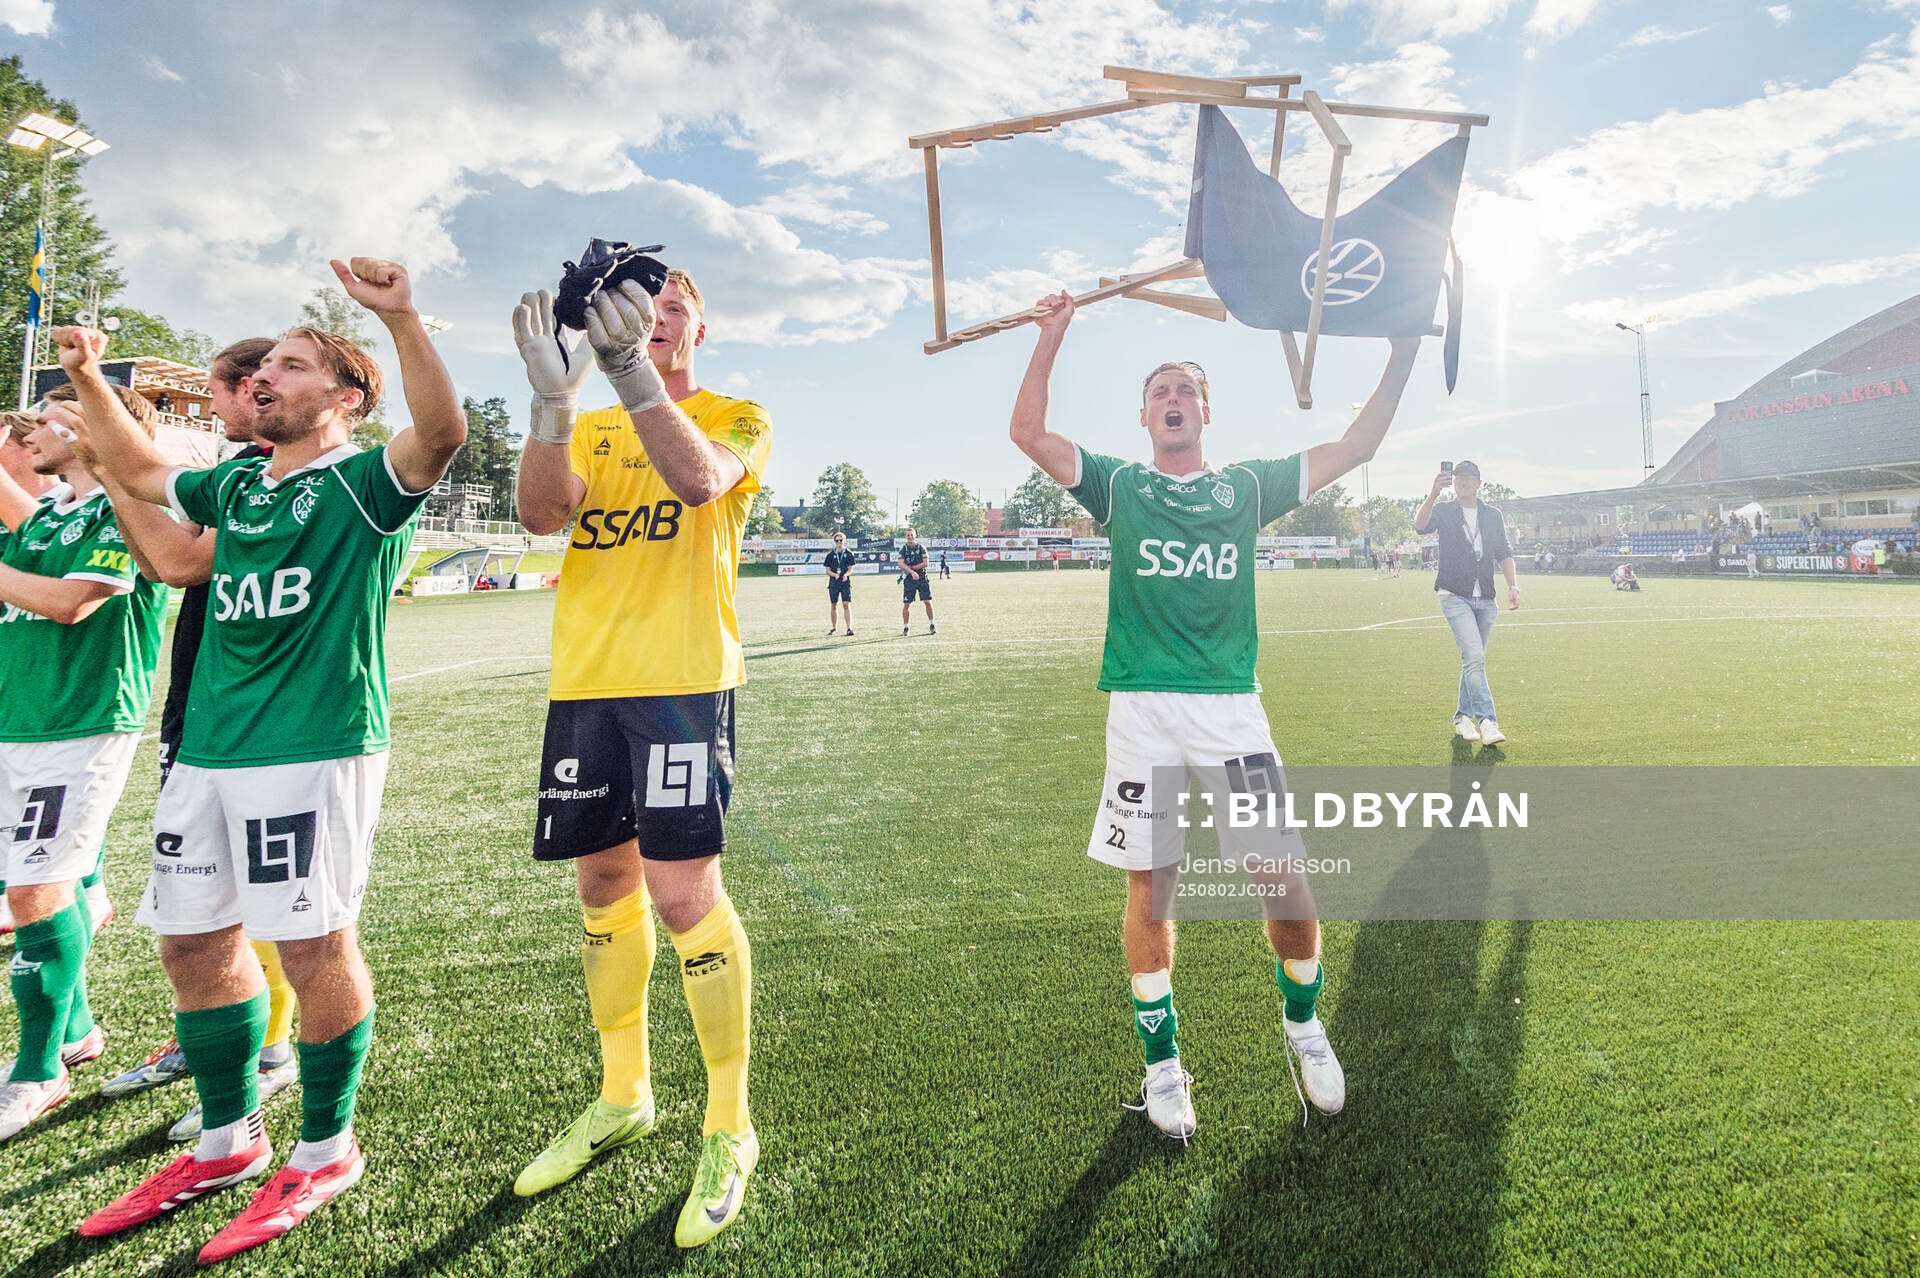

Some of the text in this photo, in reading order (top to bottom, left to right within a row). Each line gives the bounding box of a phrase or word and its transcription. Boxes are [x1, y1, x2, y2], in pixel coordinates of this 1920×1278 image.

[1838, 378, 1910, 405] ARENA
[572, 499, 683, 550] SSAB
[1136, 538, 1239, 580] SSAB
[1776, 555, 1833, 570] SUPERETTAN
[213, 566, 312, 622] SAB
[538, 783, 610, 801] orlänge Energi
[543, 814, 553, 840] 1
[1137, 809, 1169, 821] Energi
[1105, 823, 1127, 851] 22
[176, 862, 218, 877] Energi
